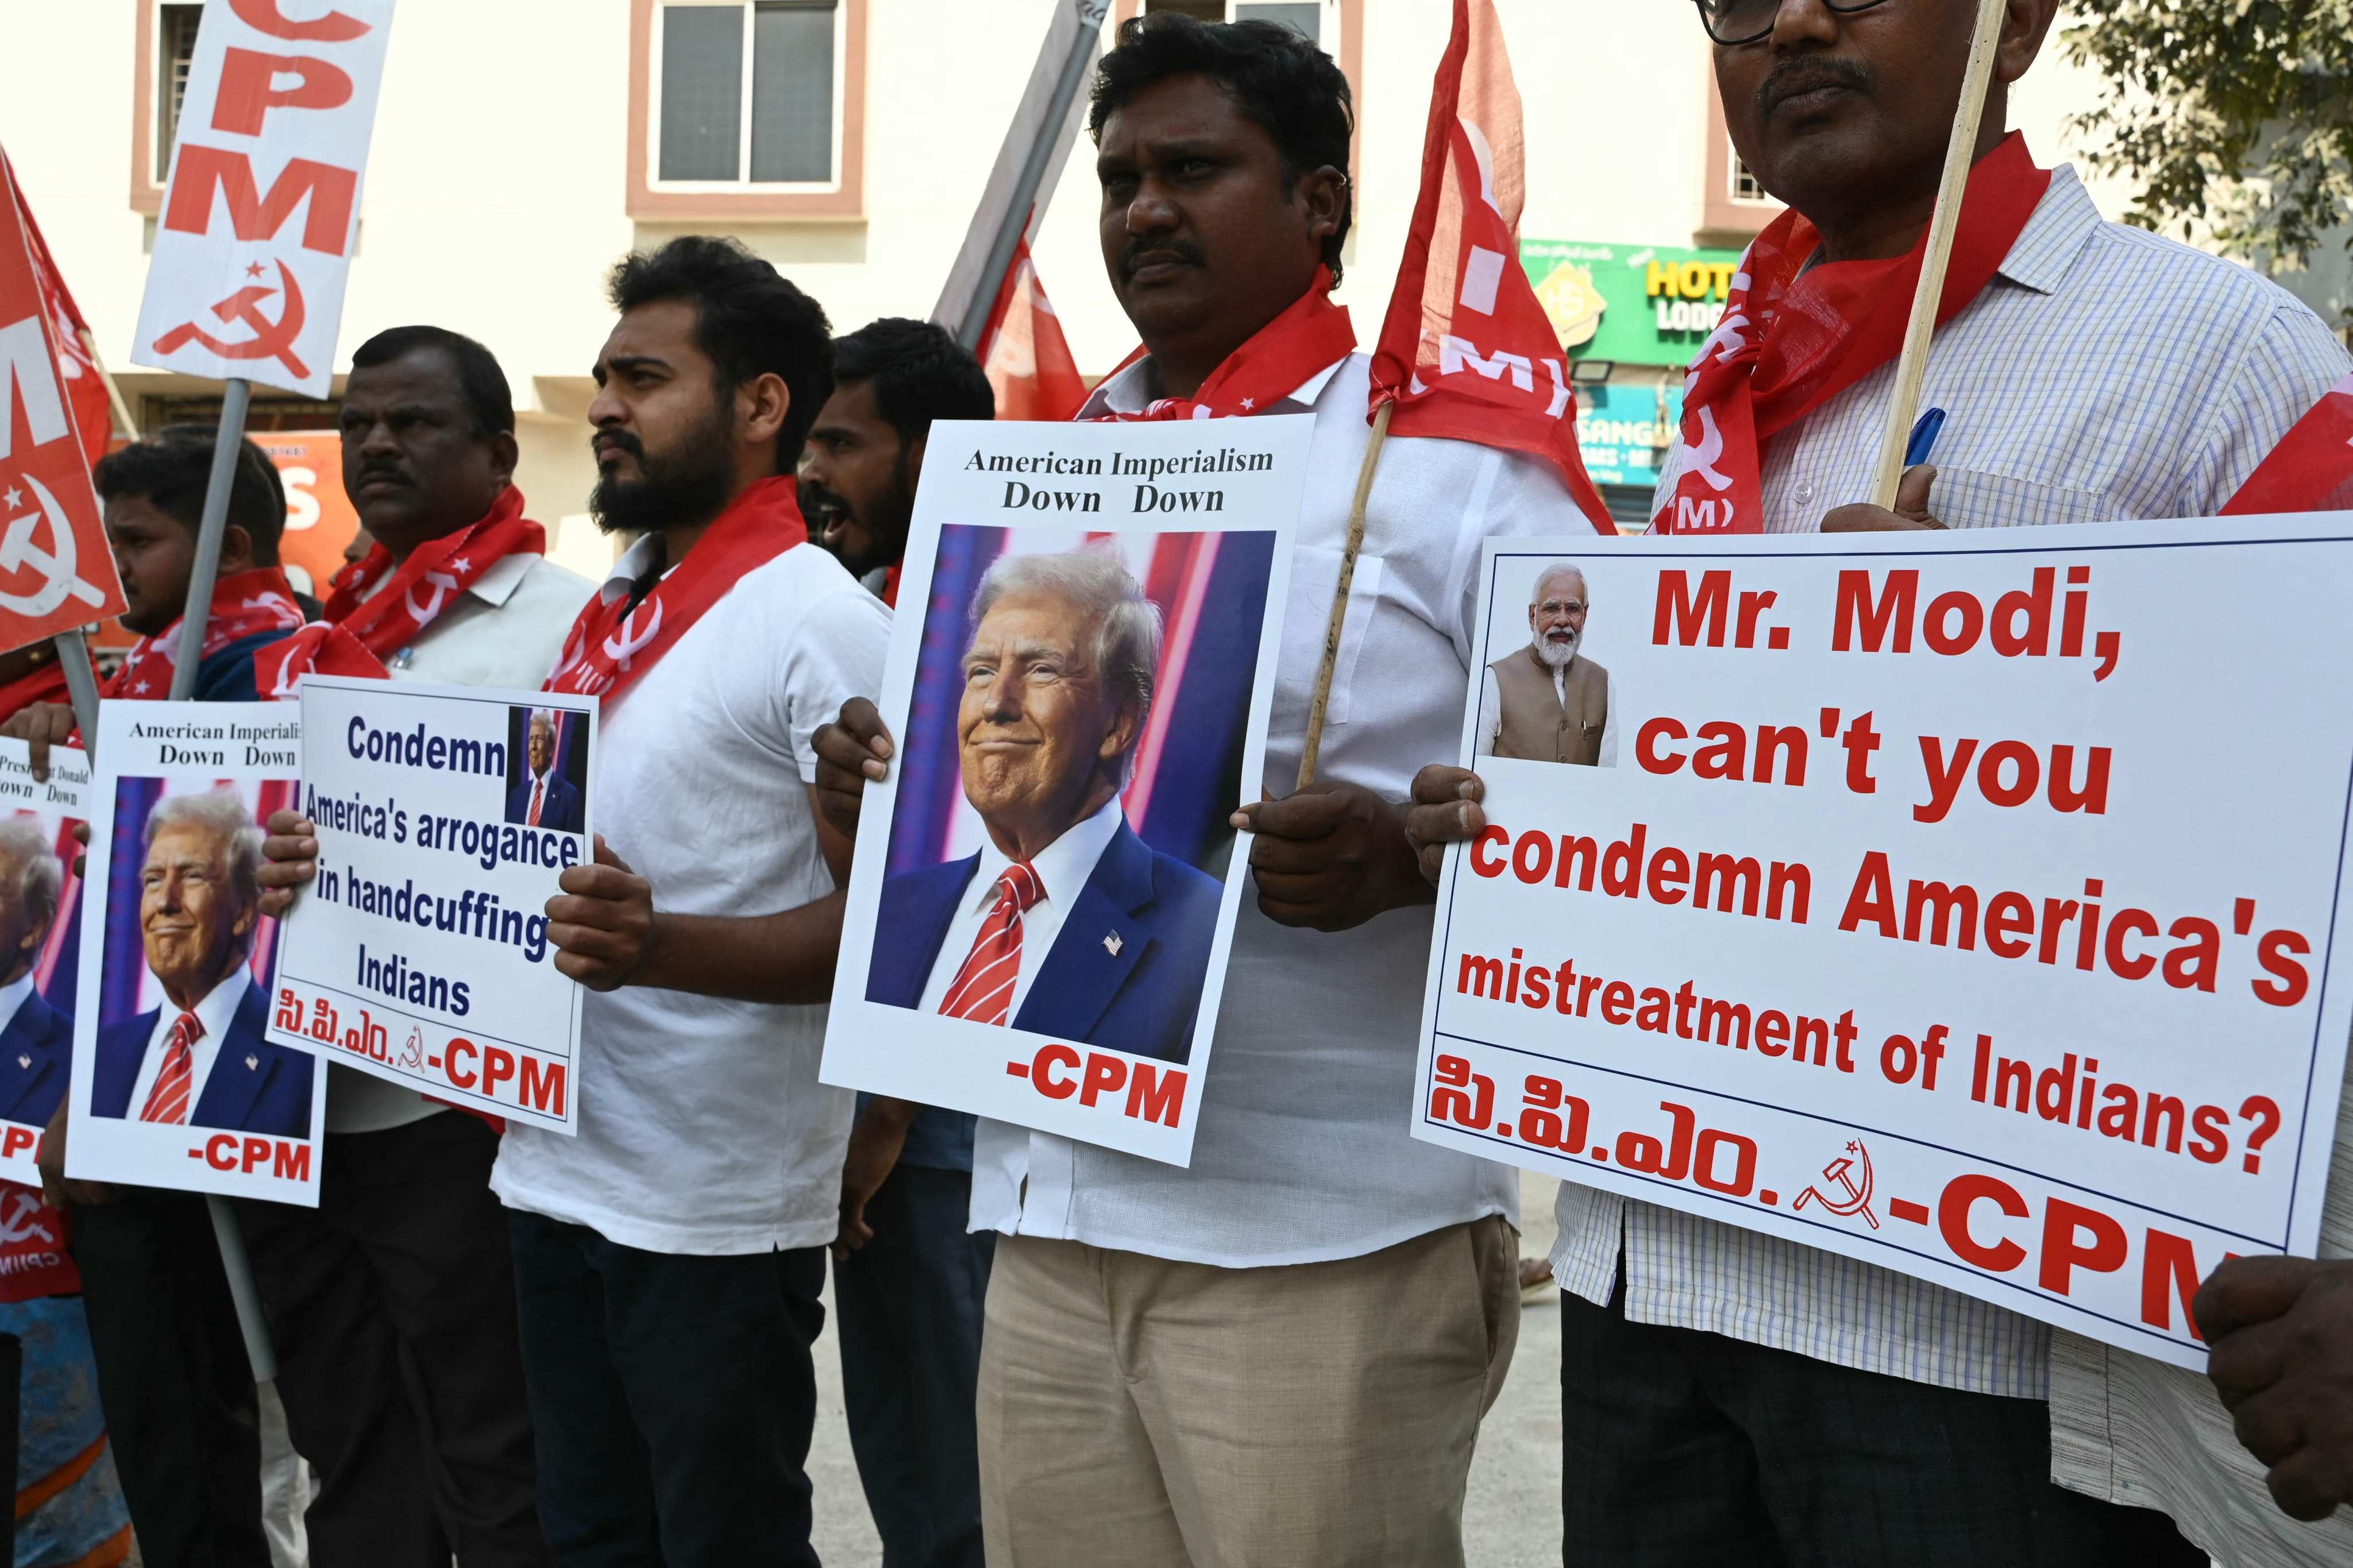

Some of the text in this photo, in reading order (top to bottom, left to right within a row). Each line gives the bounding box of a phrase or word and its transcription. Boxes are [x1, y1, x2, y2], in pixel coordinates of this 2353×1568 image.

[964, 447, 1274, 481] American Imperialism
[1001, 481, 1224, 513] Down Down
[1652, 566, 2120, 682] Mr. Modi,
[130, 722, 223, 740] American
[159, 744, 295, 766] Down Down
[348, 716, 505, 777] Condemn
[1635, 707, 2112, 823] can't you
[0, 780, 77, 806] own Down
[58, 765, 88, 785] Donald
[306, 783, 578, 871] America's arrogance
[317, 858, 549, 963] in handcuffing
[1469, 823, 2310, 1007] condemn America's
[357, 944, 470, 1017] Indians
[428, 1037, 566, 1117] -CPM
[1006, 1044, 1188, 1129] -CPM
[1456, 948, 2281, 1175] mistreatment of Indians?
[188, 1134, 311, 1182] -CPM
